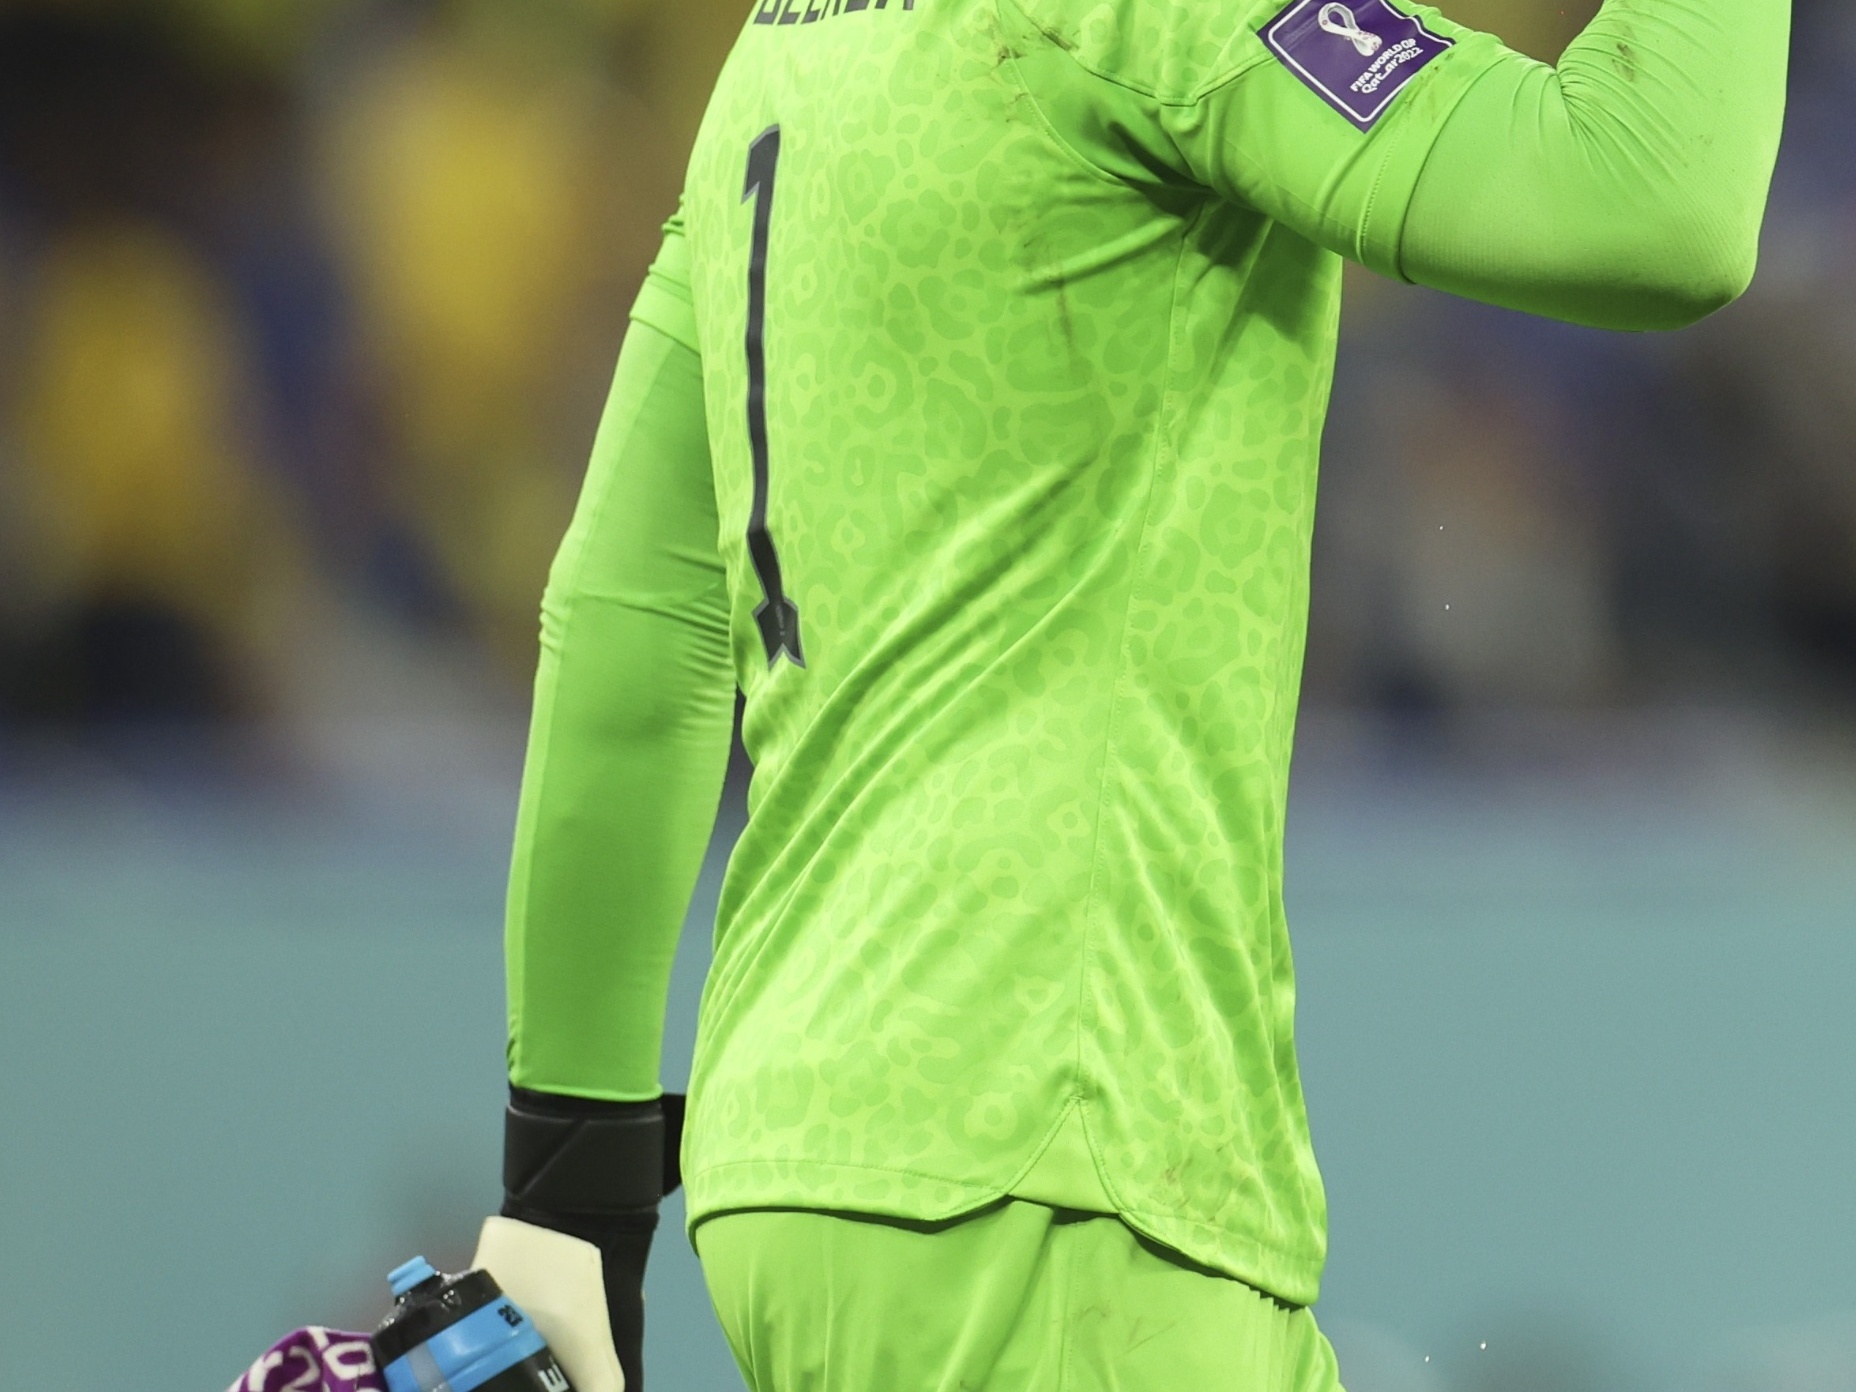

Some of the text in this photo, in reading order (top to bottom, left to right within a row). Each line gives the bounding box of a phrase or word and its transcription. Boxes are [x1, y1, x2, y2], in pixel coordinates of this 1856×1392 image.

[1350, 71, 1373, 92] FIFA
[1368, 43, 1403, 73] WORLD
[1361, 47, 1424, 94] Qatar 2022
[741, 122, 806, 672] 1
